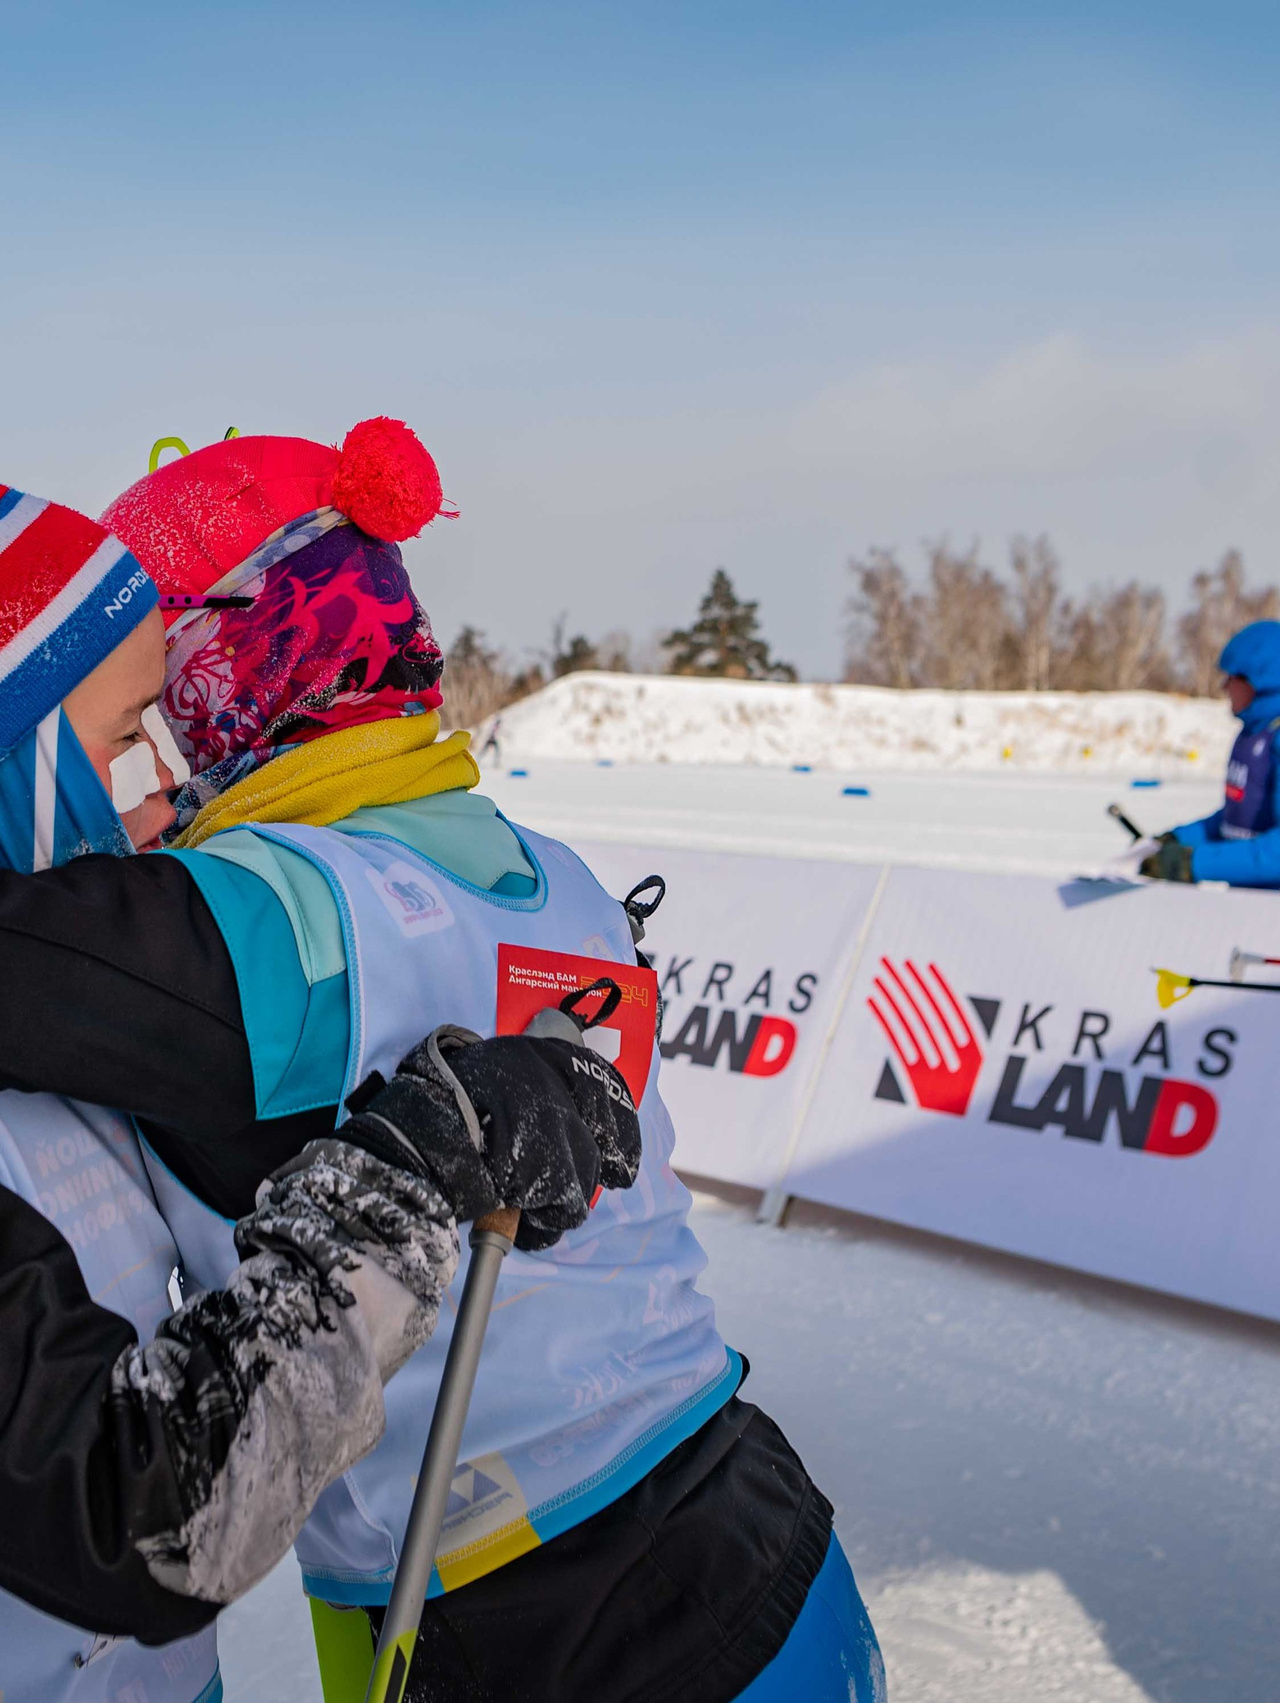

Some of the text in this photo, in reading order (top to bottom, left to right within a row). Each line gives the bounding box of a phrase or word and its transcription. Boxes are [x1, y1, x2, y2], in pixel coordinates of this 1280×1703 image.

[508, 964, 577, 984] Краслэнд БАМ
[508, 974, 560, 990] Ангарский
[660, 954, 819, 1014] KRAS
[1012, 1002, 1239, 1078] KRAS
[572, 1056, 638, 1115] NORDS
[987, 1055, 1219, 1160] LAND
